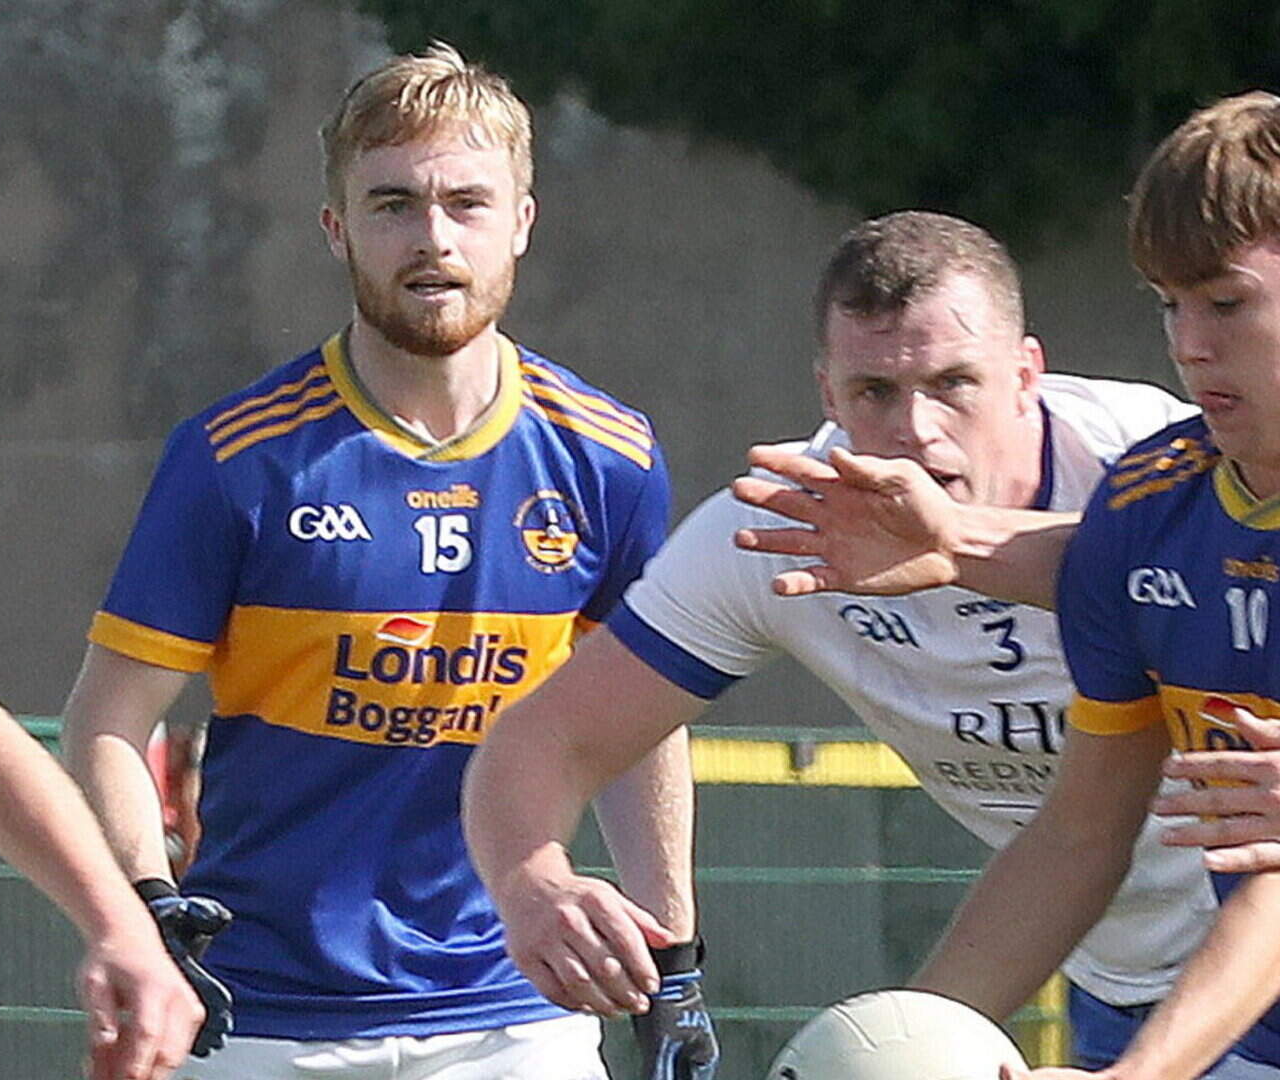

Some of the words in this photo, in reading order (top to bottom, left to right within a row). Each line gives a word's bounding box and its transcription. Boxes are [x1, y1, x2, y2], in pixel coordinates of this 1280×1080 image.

[414, 514, 472, 574] 15
[333, 634, 528, 686] Londis
[983, 616, 1025, 671] 3
[951, 701, 1064, 755] RH
